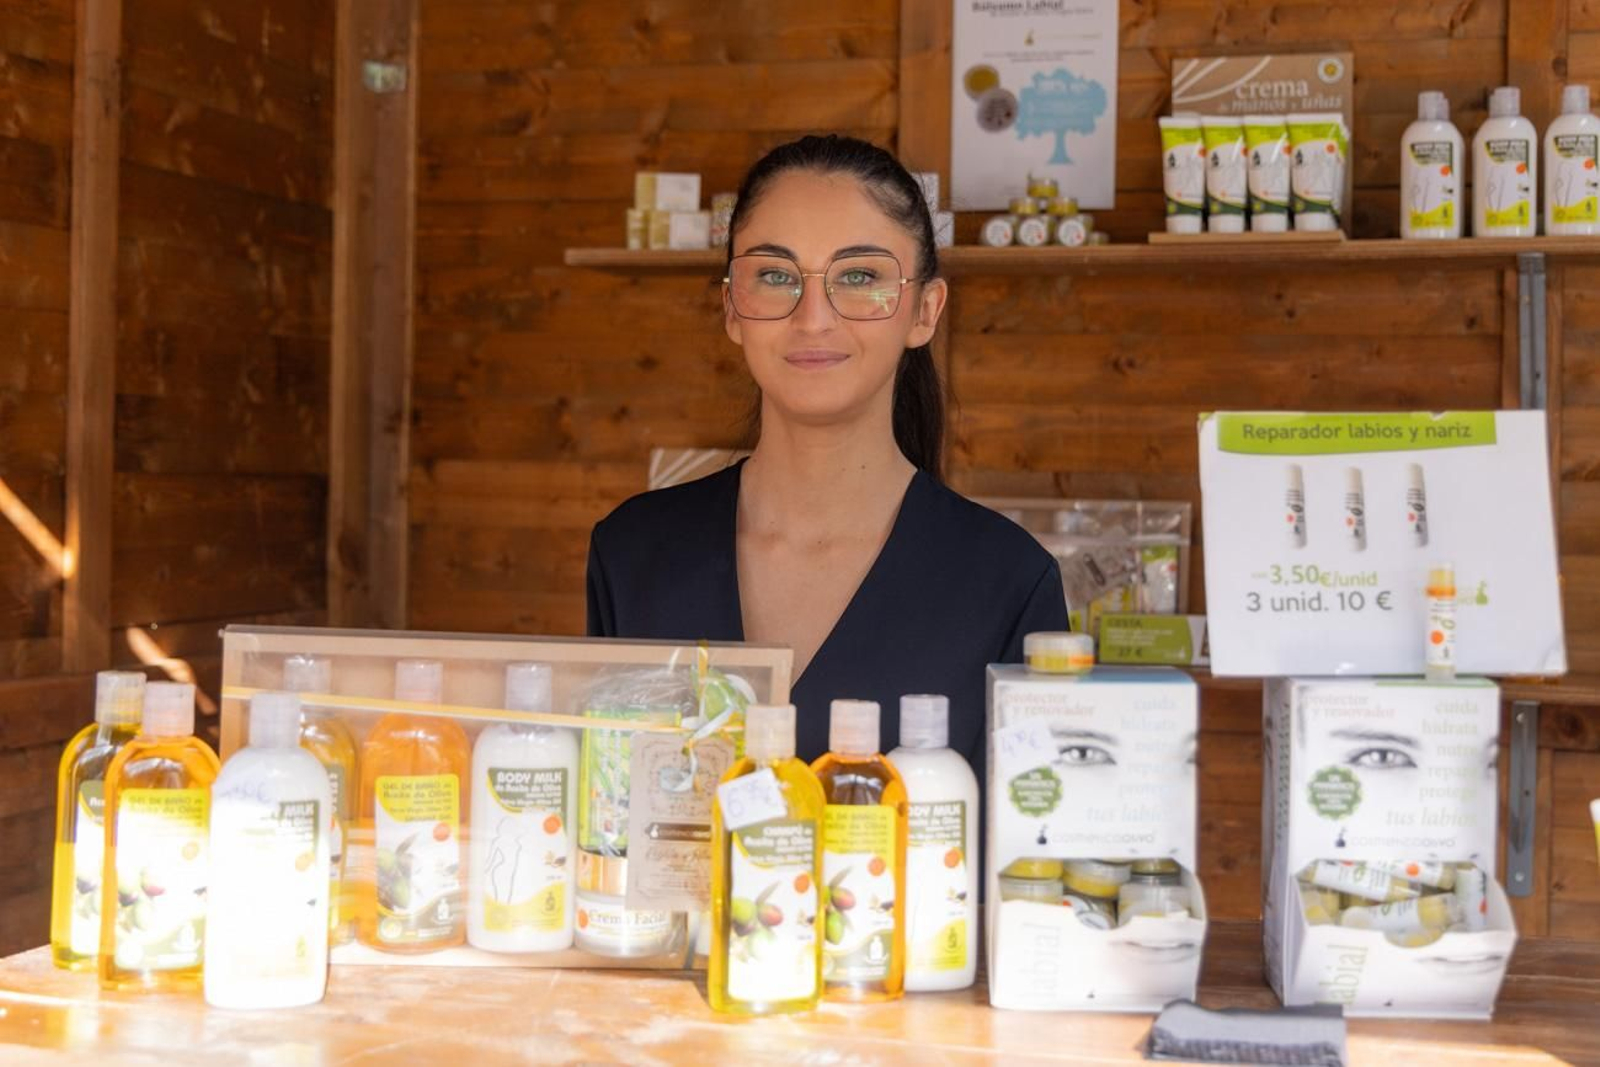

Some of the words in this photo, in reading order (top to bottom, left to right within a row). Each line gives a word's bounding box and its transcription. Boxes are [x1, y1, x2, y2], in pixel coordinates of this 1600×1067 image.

[1235, 78, 1309, 99] crema
[1232, 97, 1287, 112] manos
[1302, 94, 1342, 109] uñas
[1242, 423, 1342, 443] Reparador
[1349, 422, 1403, 439] labios
[1409, 426, 1419, 442] y
[1425, 422, 1472, 438] nariz
[1246, 591, 1262, 612] 3
[1270, 591, 1329, 612] unid.
[1338, 591, 1366, 611] 10
[1375, 590, 1393, 611] €
[1004, 693, 1069, 707] protector
[1302, 694, 1369, 709] protector
[1435, 700, 1477, 715] cuida
[1024, 703, 1095, 717] renovador
[1324, 703, 1397, 718] renovador
[1421, 718, 1477, 734] hidrata
[496, 771, 531, 784] BODY
[533, 771, 562, 783] MILK
[933, 804, 961, 817] MILK
[1386, 810, 1417, 827] tus
[1420, 806, 1477, 827] labios
[635, 908, 667, 925] Facial
